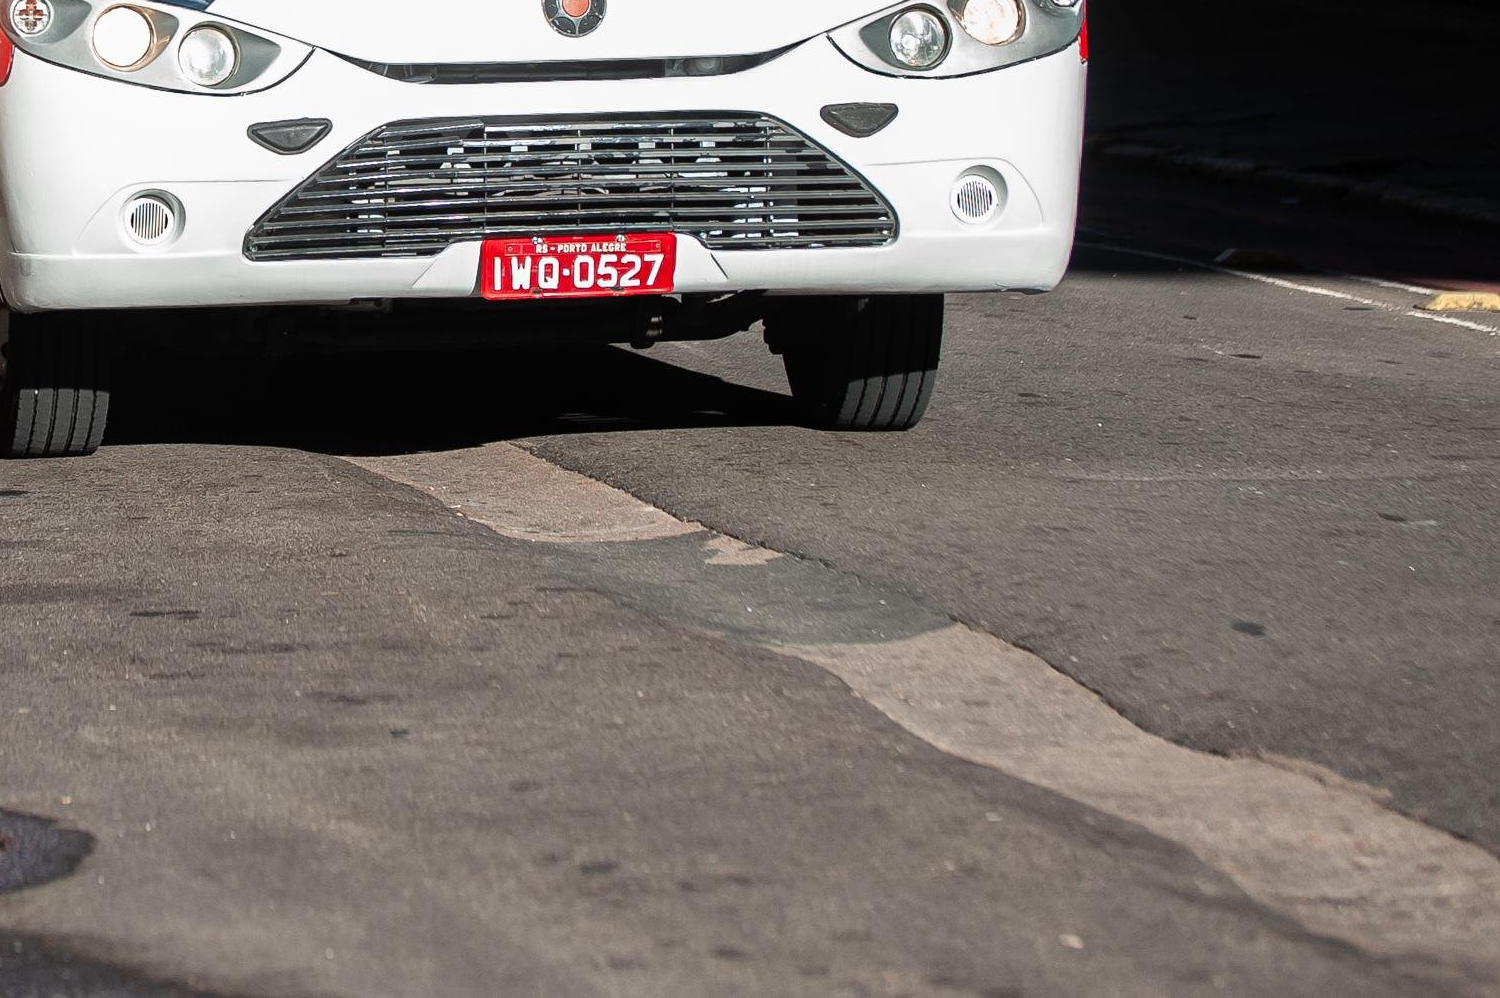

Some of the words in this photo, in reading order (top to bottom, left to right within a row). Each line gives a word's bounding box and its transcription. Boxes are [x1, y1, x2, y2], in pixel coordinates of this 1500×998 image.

[535, 243, 549, 254] RS
[557, 243, 588, 254] PORTO
[590, 242, 627, 253] ALEGRE
